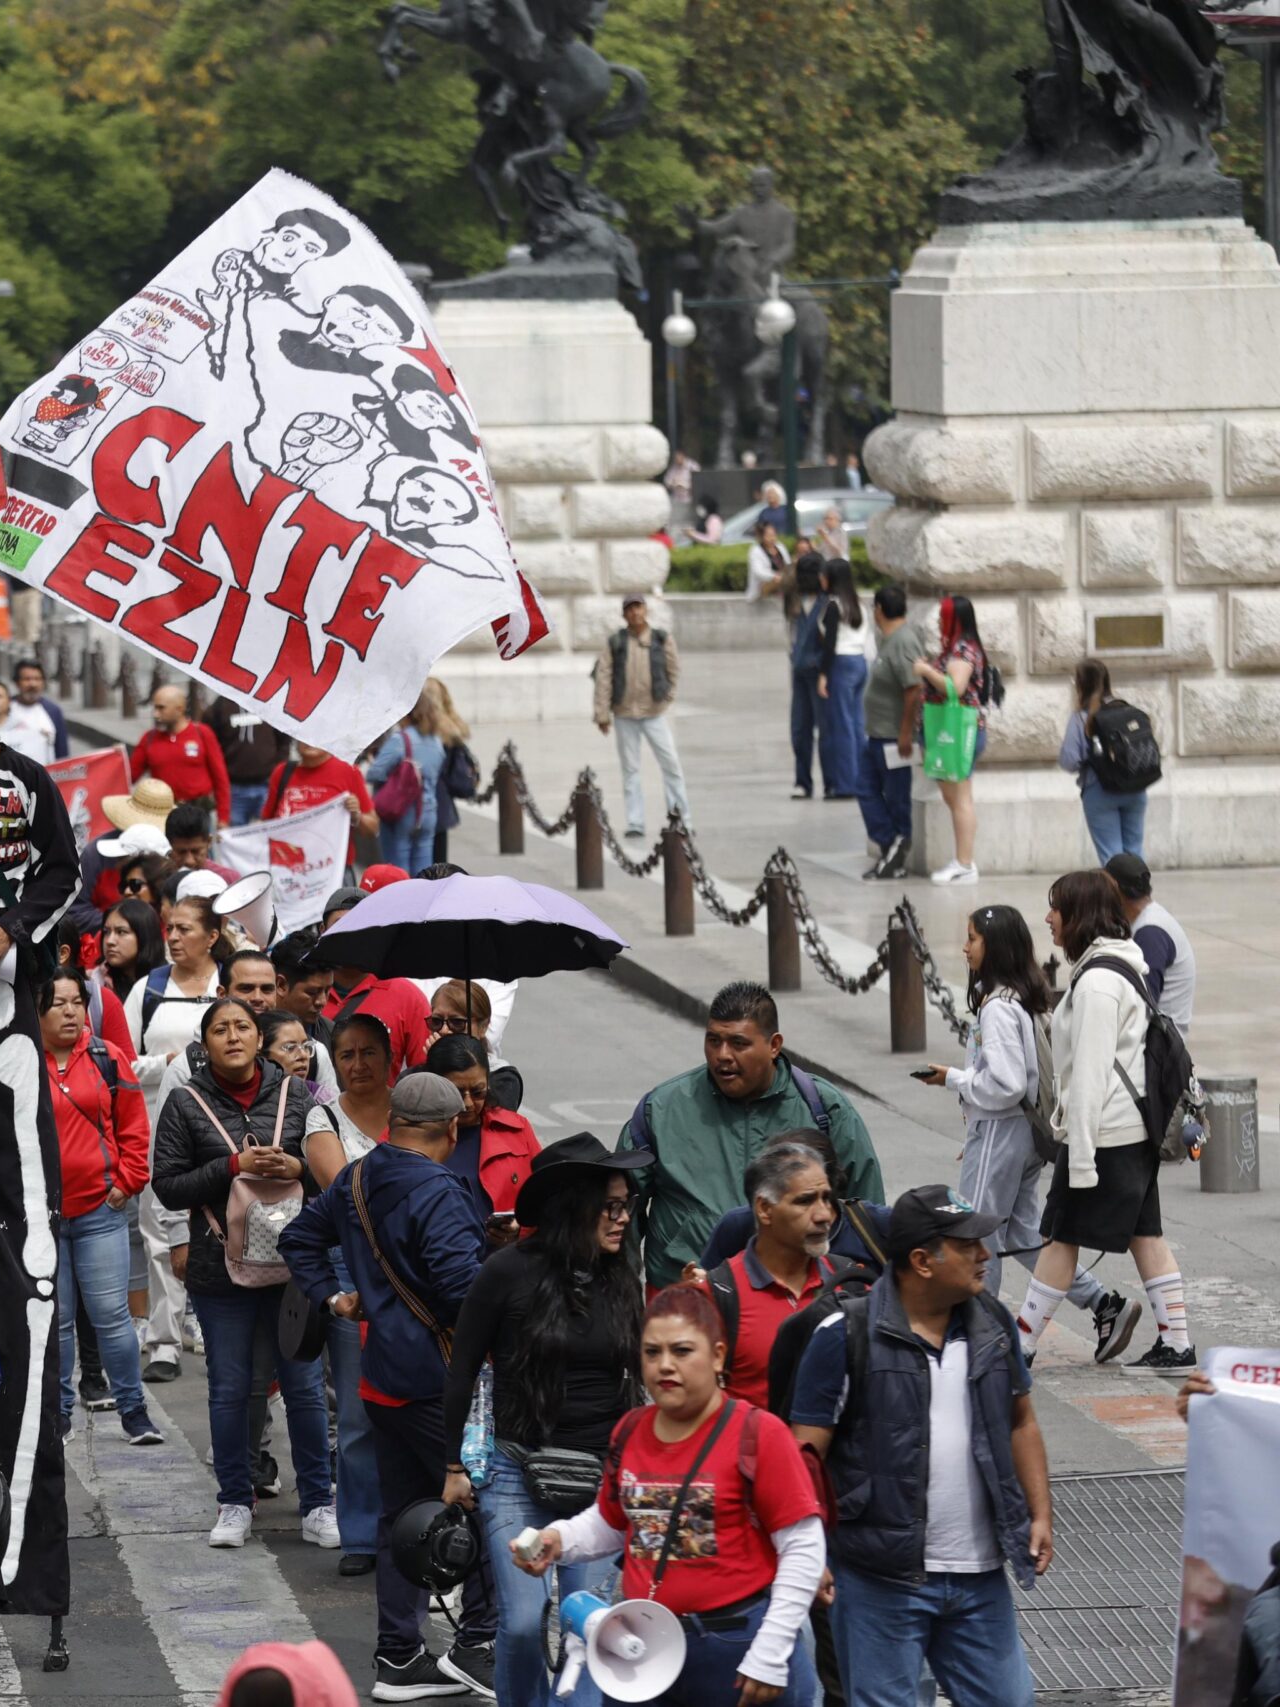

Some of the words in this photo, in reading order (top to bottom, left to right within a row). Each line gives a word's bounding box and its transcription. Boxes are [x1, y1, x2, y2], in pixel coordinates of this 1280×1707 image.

[102, 340, 115, 352] YA
[91, 406, 431, 661] CNTE
[449, 458, 498, 516] AYO
[44, 512, 345, 722] EZLN
